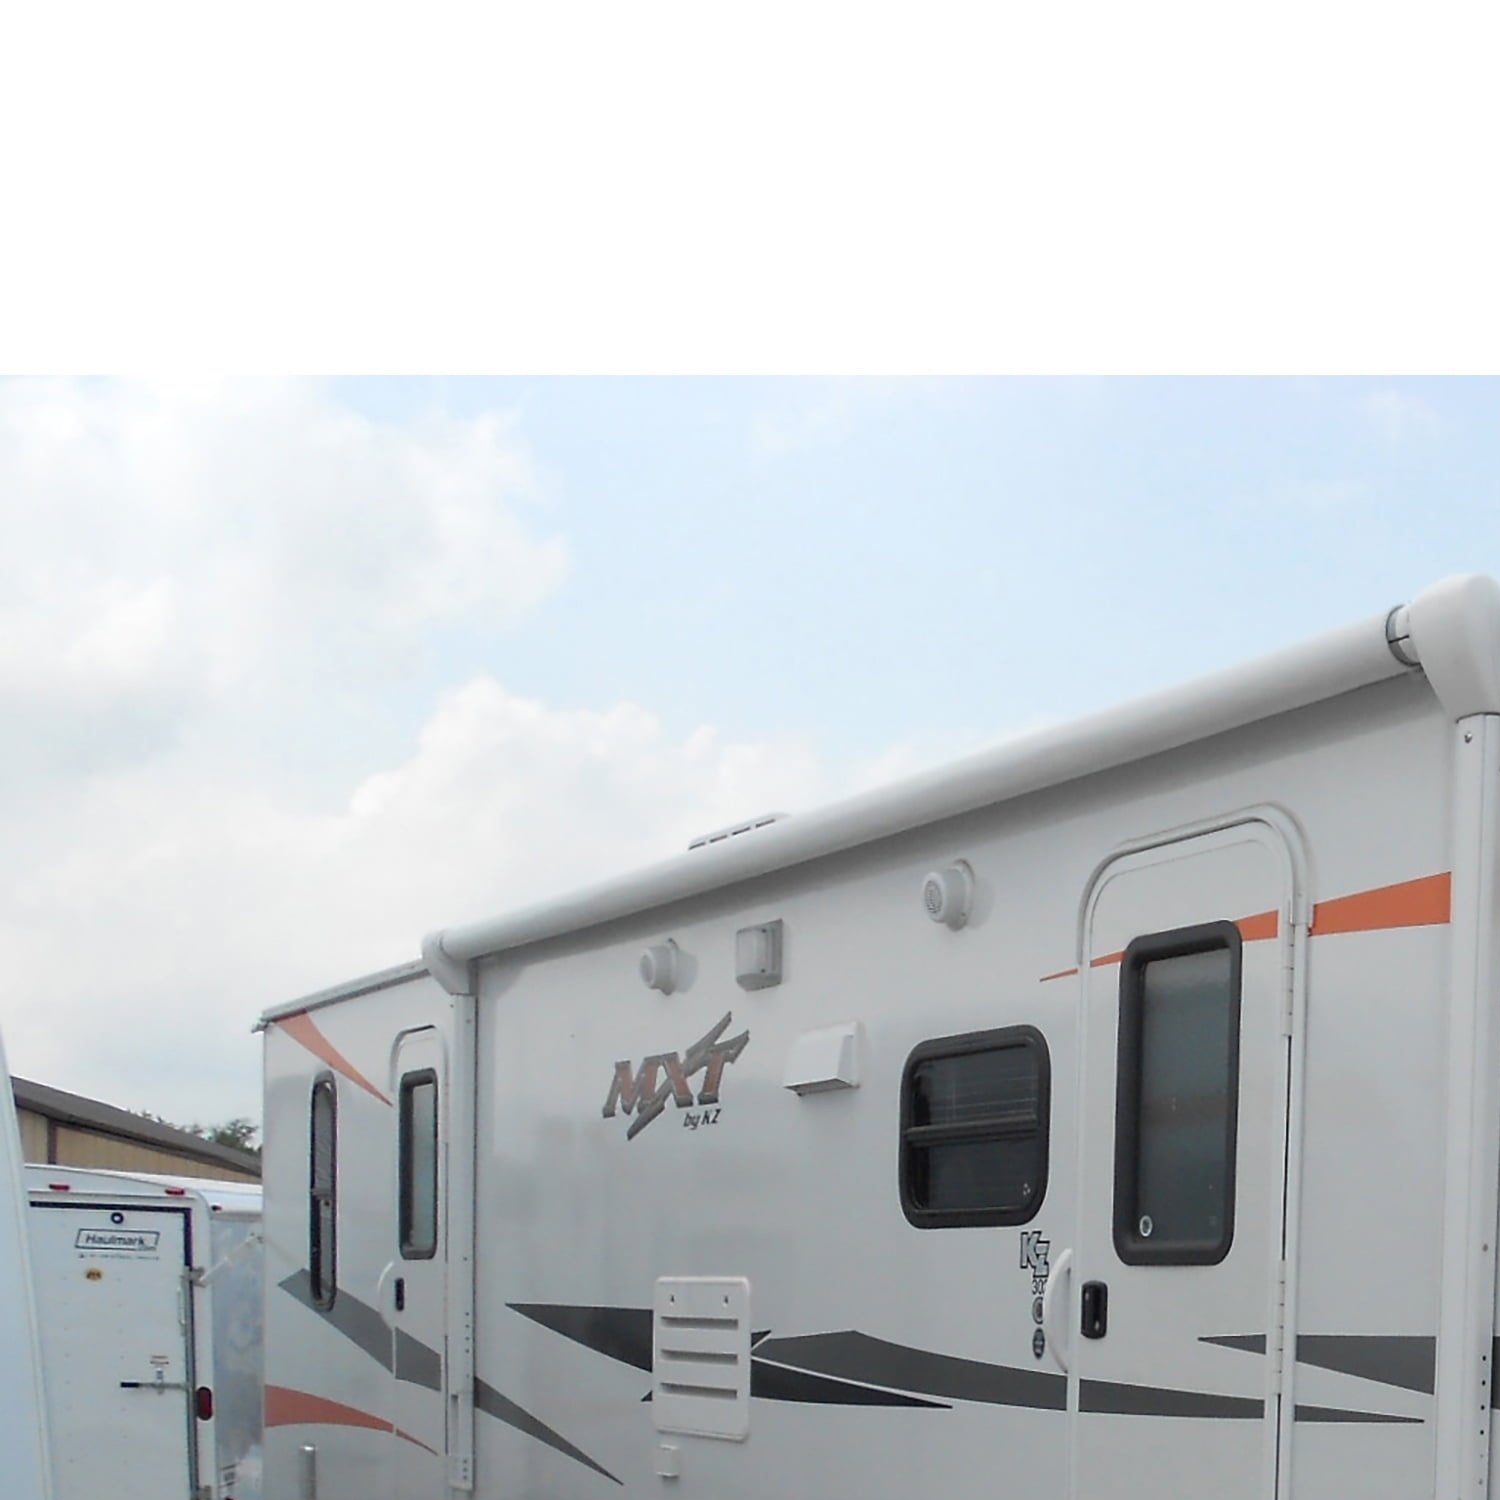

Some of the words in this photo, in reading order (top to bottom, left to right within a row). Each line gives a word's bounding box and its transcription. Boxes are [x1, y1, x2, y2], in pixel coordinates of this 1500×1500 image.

[602, 1011, 750, 1141] MXT
[683, 1112, 700, 1130] by
[701, 1108, 721, 1126] KZ
[85, 1233, 145, 1247] Haulmark
